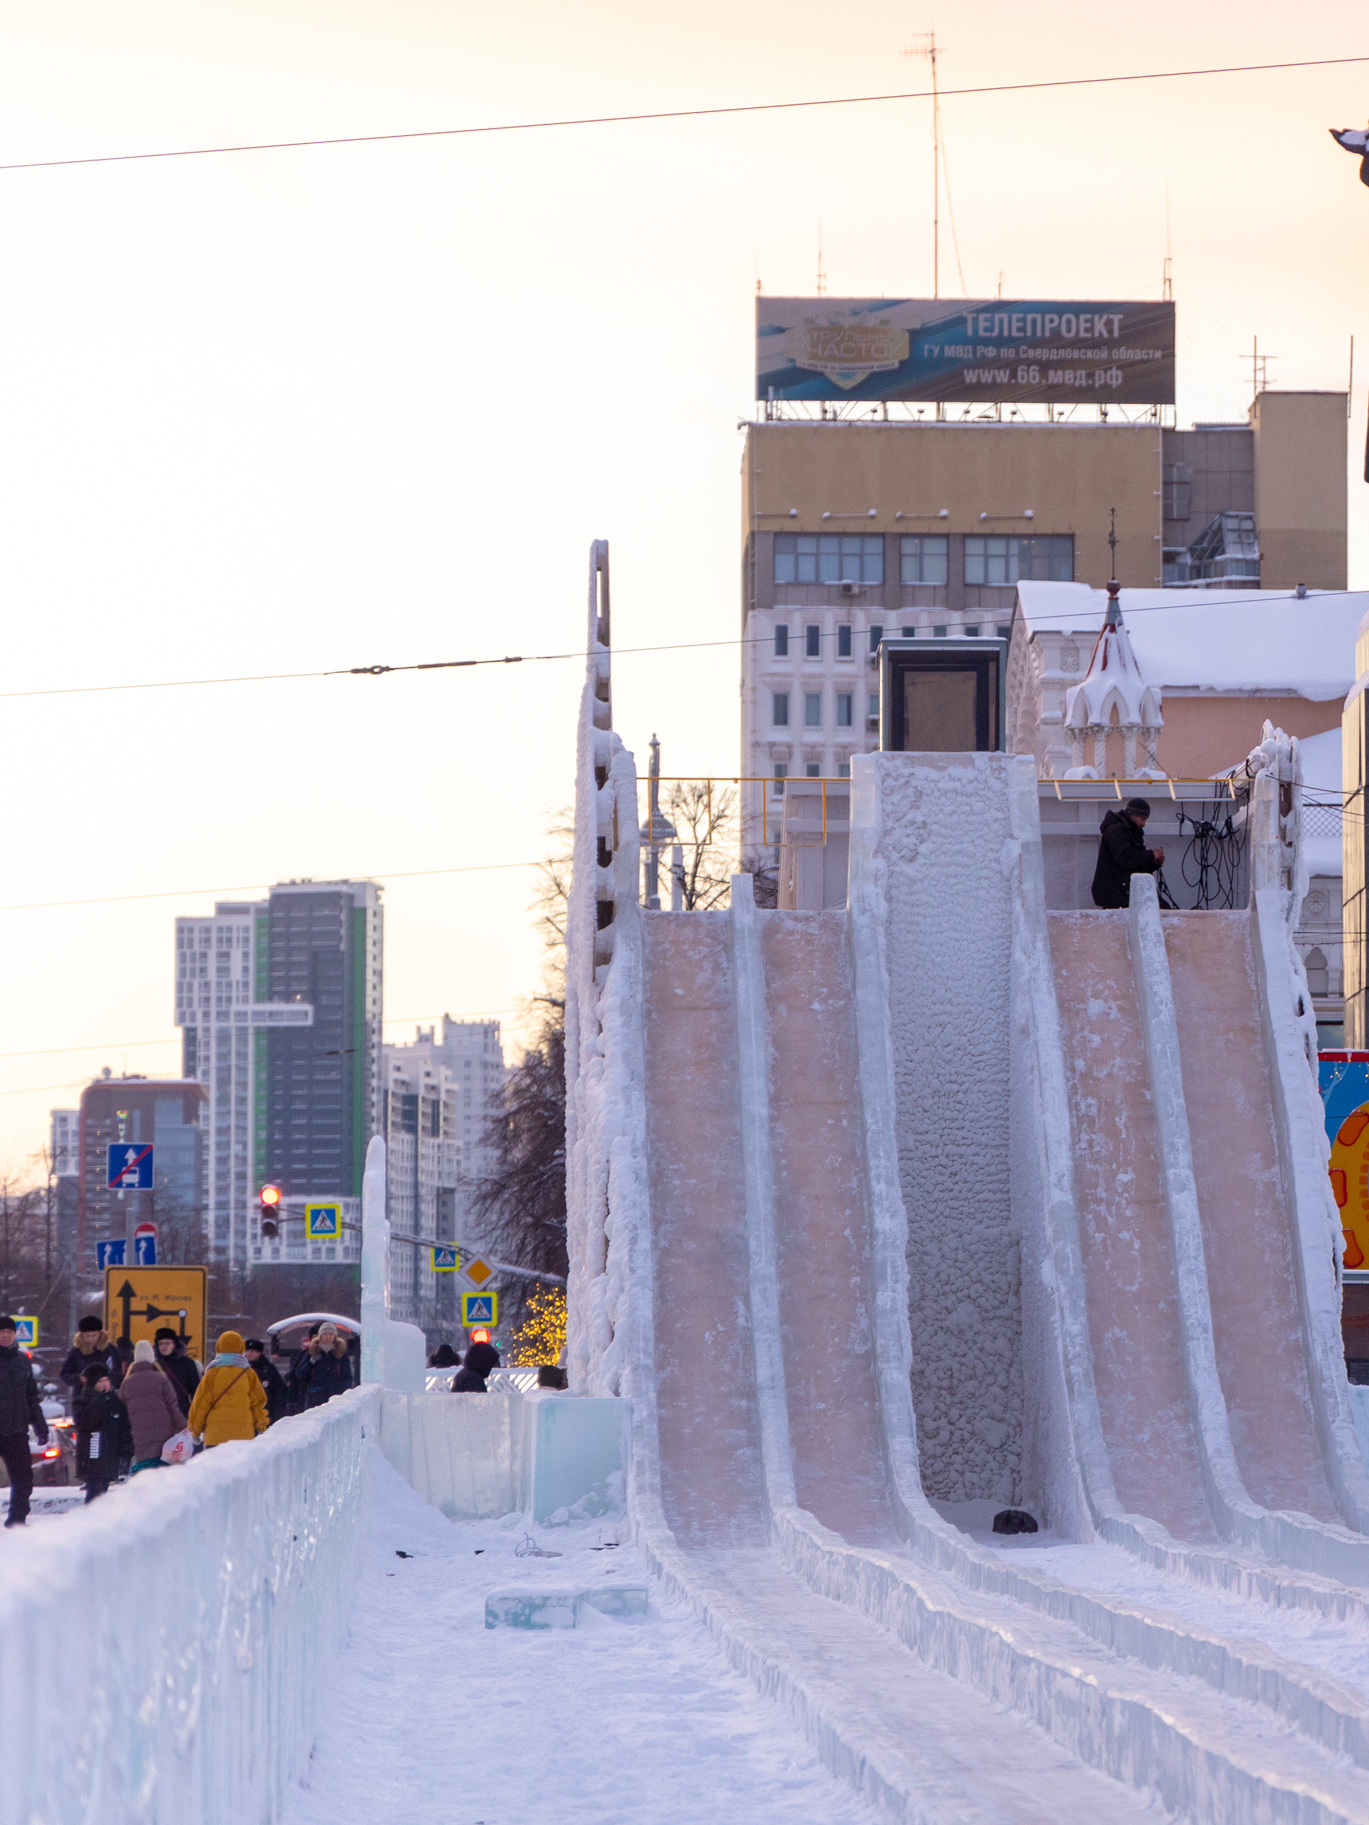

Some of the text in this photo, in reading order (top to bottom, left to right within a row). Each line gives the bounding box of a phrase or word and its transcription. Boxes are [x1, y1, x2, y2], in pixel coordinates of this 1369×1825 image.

[963, 312, 1124, 338] ТЕЛЕПРОЕКТ
[923, 344, 1163, 361] ГУ МВД РФ по Свердловской области
[963, 365, 1123, 388] www.66.мвд.рф
[89, 1431, 100, 1459] PUMA
